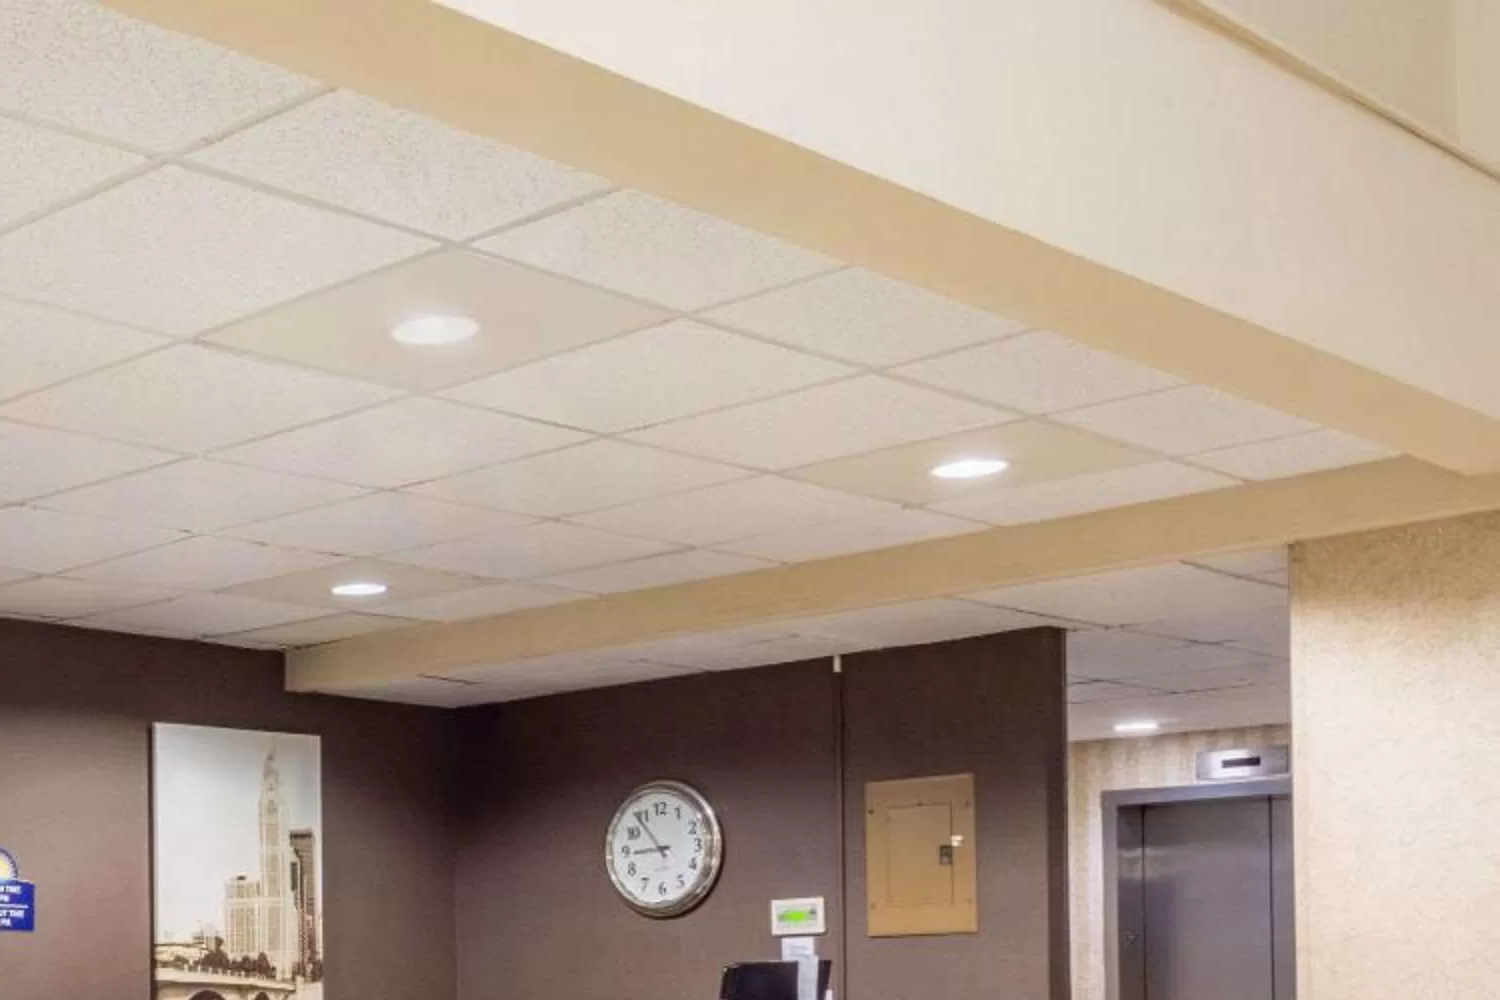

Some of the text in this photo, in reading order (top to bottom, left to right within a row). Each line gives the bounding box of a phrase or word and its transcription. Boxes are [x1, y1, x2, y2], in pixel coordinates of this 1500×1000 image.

[654, 801, 667, 816] 12
[674, 805, 682, 821] 1
[627, 825, 641, 840] 10
[688, 820, 697, 835] 2
[621, 845, 631, 858] 9
[693, 837, 702, 852] 3
[627, 861, 637, 876] 8
[688, 857, 697, 870] 4
[641, 877, 650, 894] 7
[658, 881, 668, 896] 6
[675, 873, 685, 889] 5
